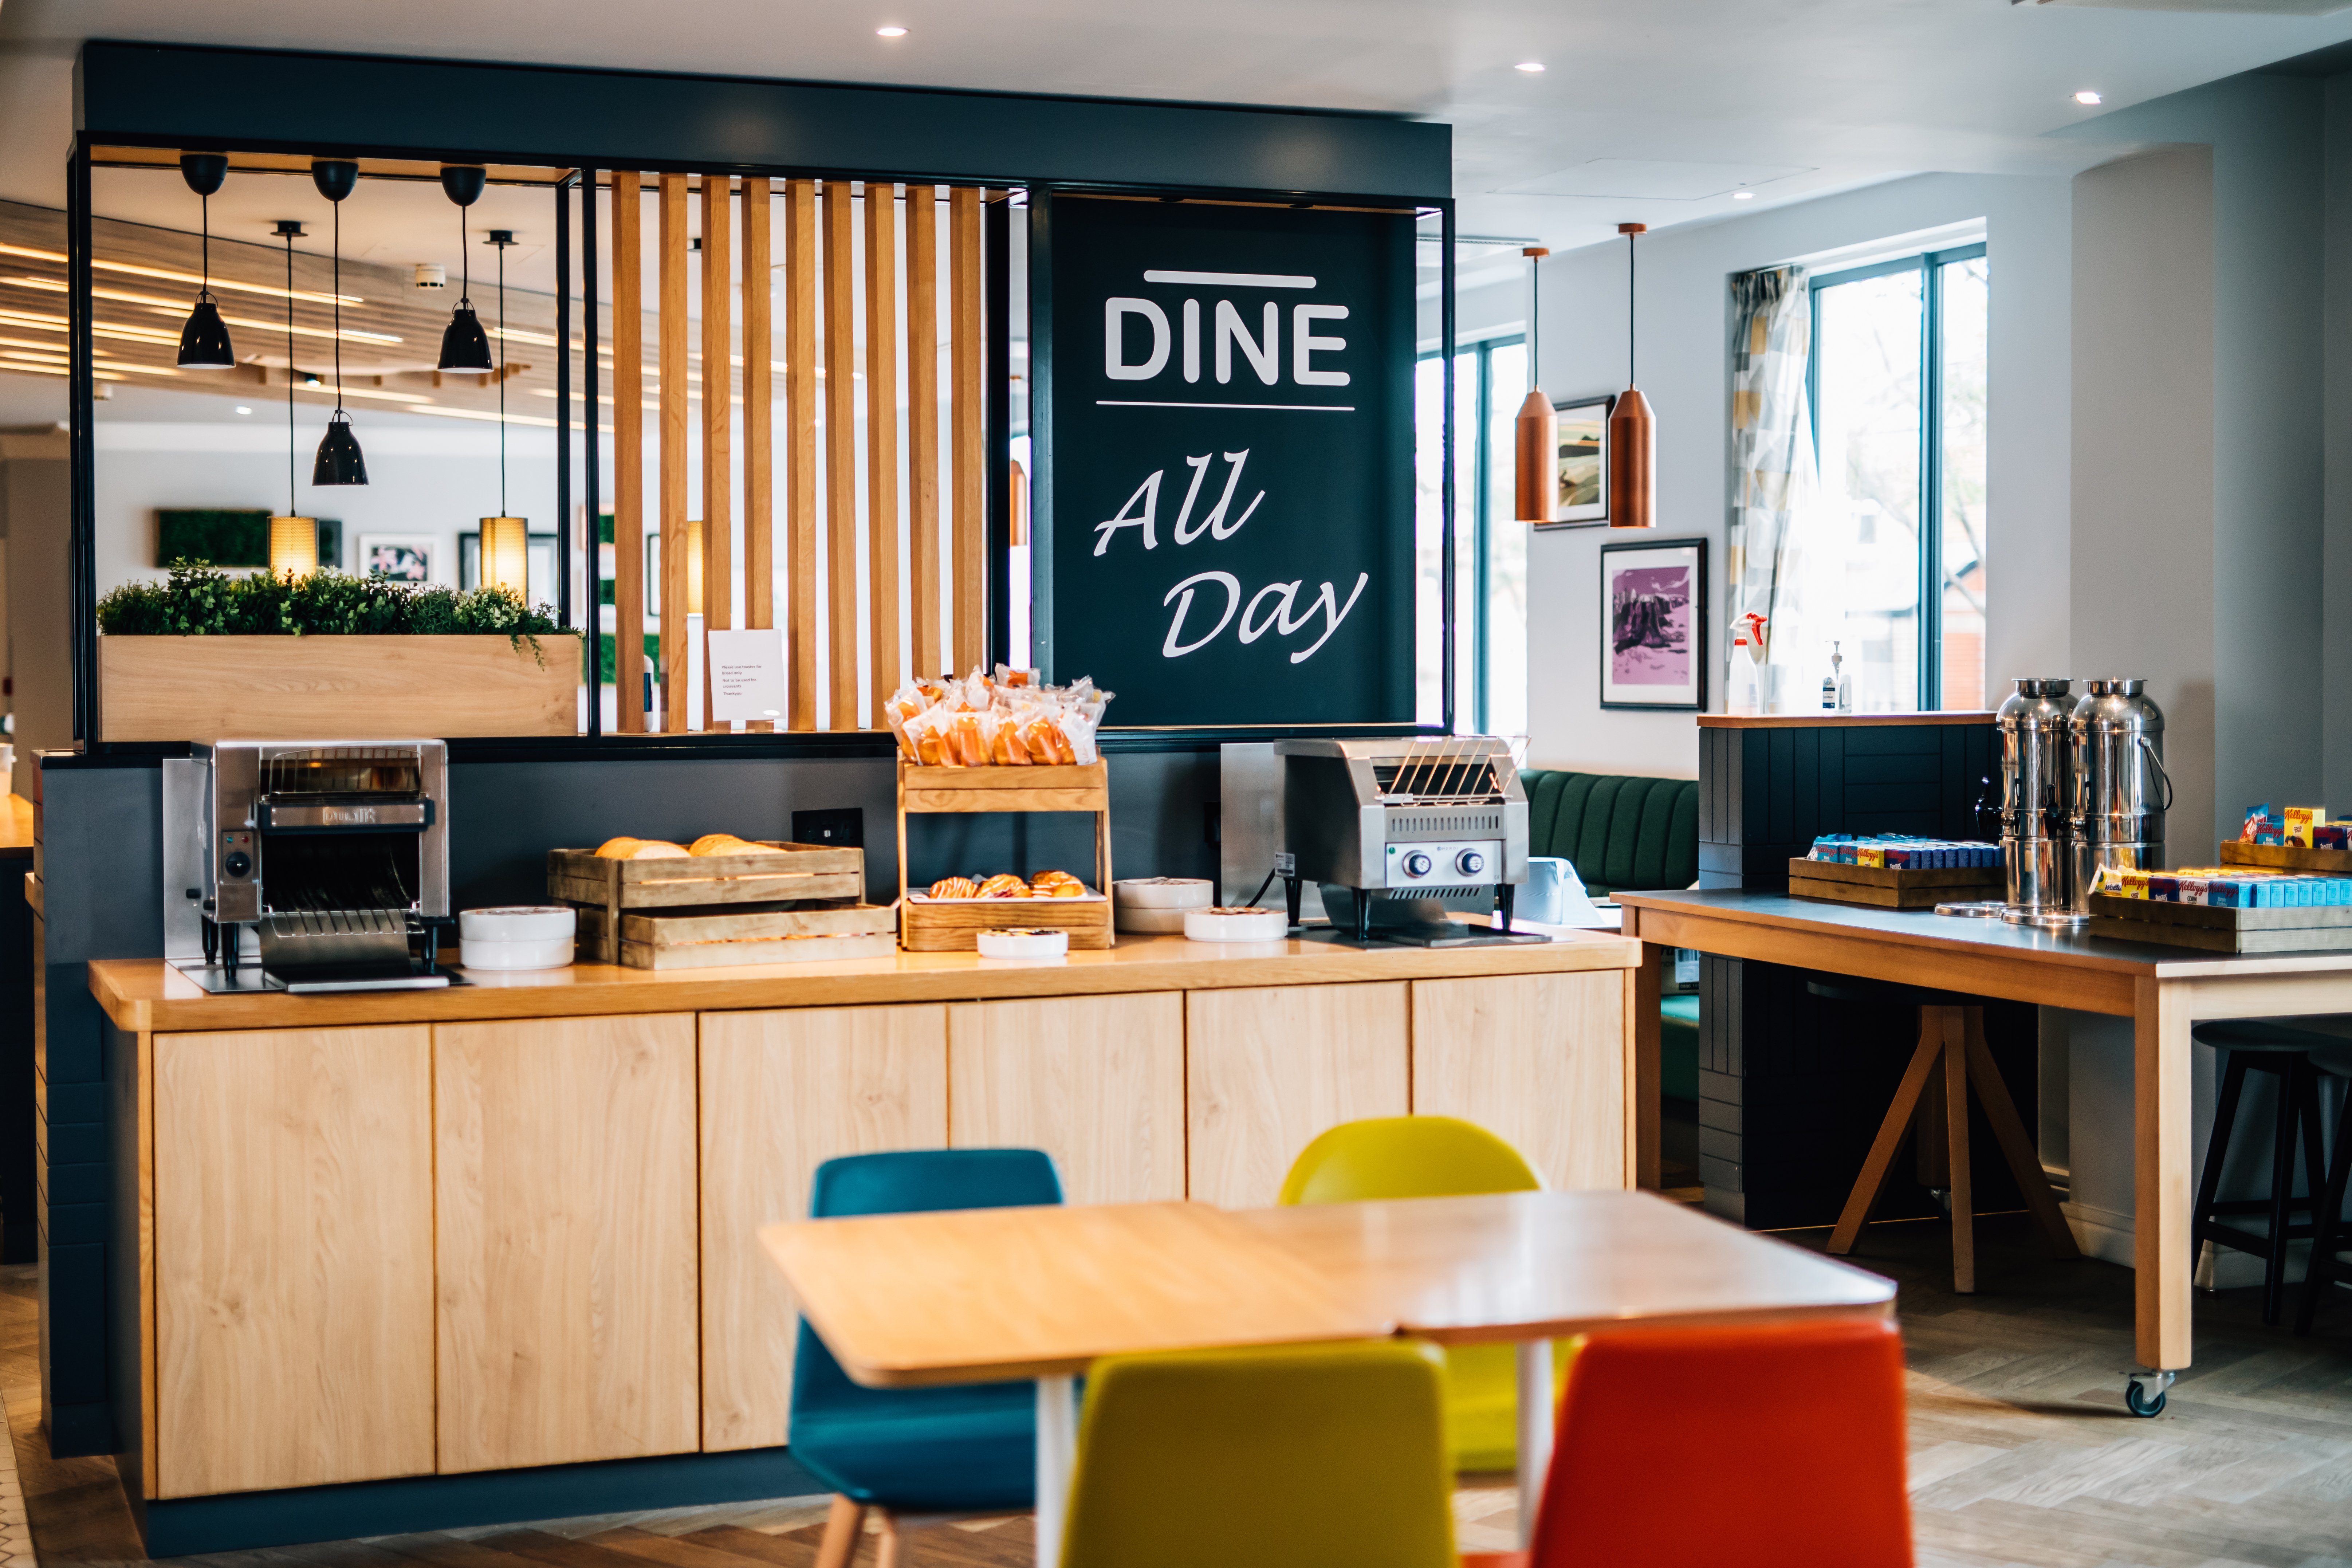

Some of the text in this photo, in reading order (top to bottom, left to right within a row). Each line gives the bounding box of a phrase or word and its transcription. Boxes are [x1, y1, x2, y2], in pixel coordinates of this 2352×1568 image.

[1106, 298, 1350, 386] DINE
[1094, 448, 1265, 556] All
[1163, 571, 1368, 664] Day
[322, 808, 375, 823] Dualit
[2285, 809, 2313, 824] Kellogg's
[1840, 845, 1857, 858] Kellogg
[1857, 848, 1879, 861] Kellogg's
[2121, 876, 2148, 890] Kellogg's
[2179, 880, 2208, 896] Kellogg's
